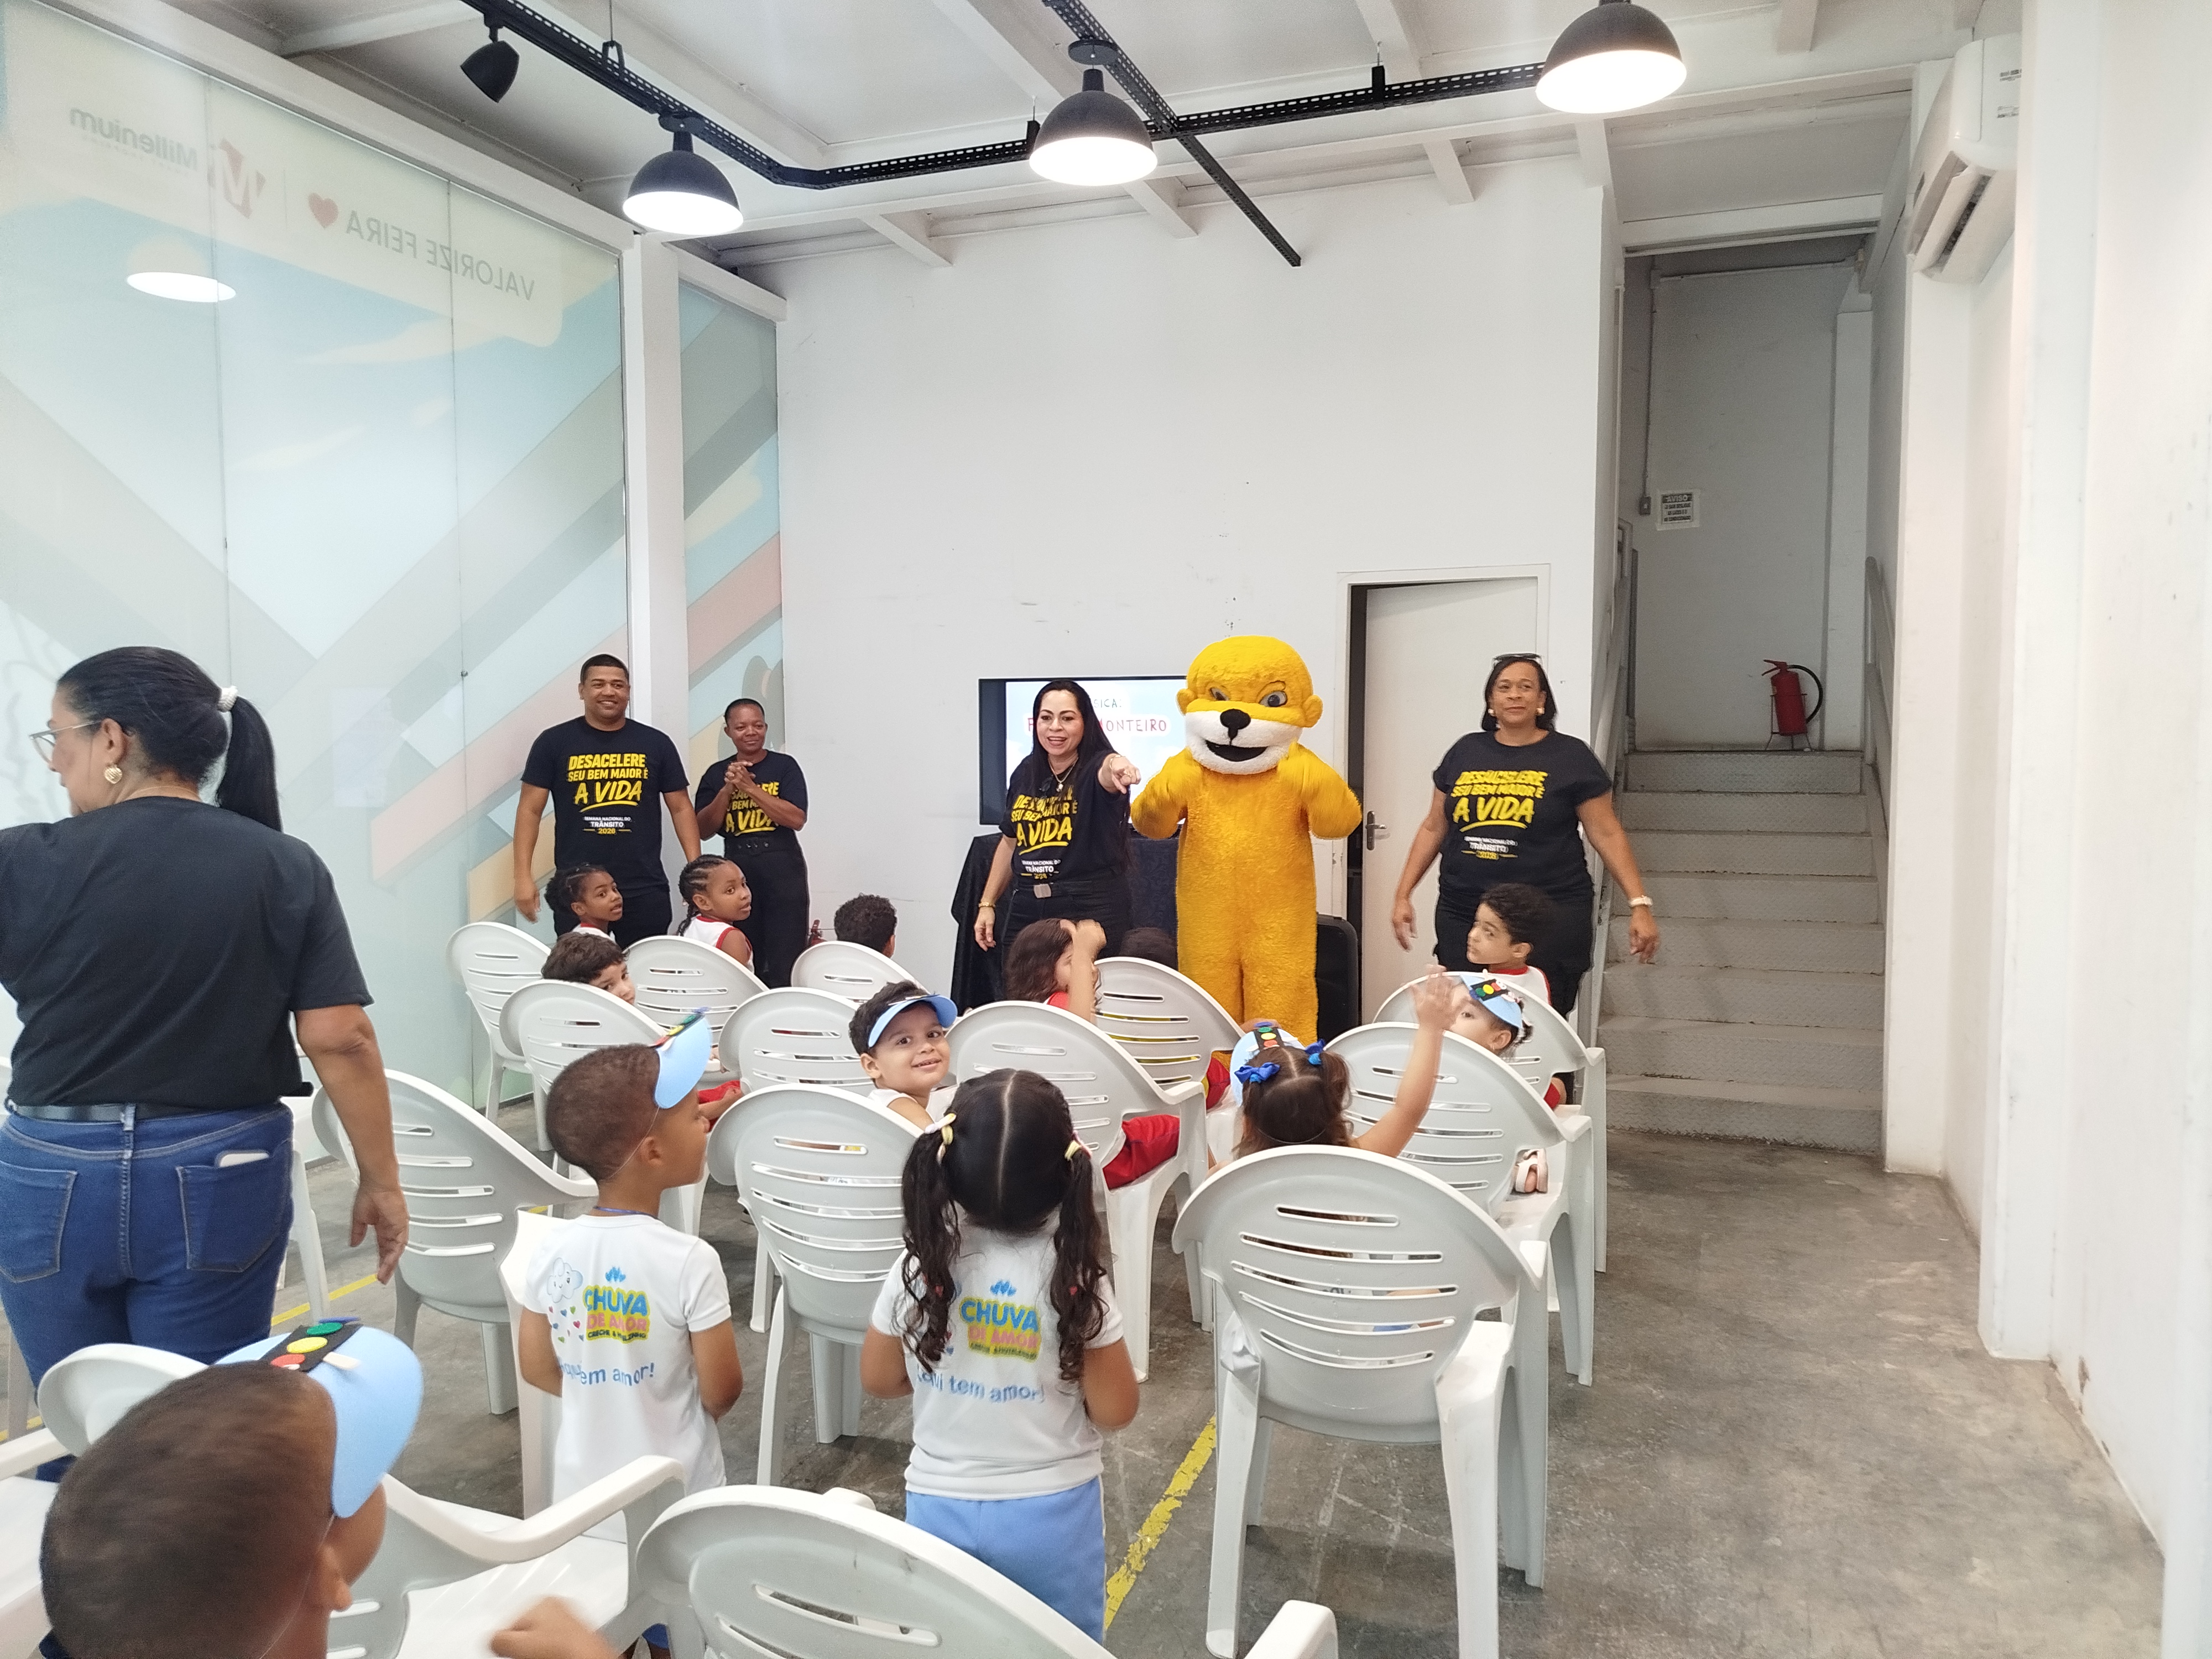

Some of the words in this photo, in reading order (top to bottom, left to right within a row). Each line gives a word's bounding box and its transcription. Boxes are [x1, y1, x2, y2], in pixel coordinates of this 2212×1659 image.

[1093, 698, 1122, 708] SICA:
[1100, 718, 1167, 732] ONTEIRO
[568, 753, 646, 770] DESACELERE
[568, 770, 586, 782] SEU
[587, 769, 608, 780] BEM
[610, 768, 642, 779] MAIOR
[644, 767, 649, 779] É
[575, 782, 589, 805] A
[596, 780, 643, 803] VIDA
[732, 800, 749, 811] BEM
[1452, 797, 1470, 823] A
[1477, 796, 1535, 824] VIDA
[726, 812, 735, 833] A
[1016, 822, 1027, 847] A
[1029, 816, 1073, 846] VIDA
[585, 1288, 648, 1317] CHUVA
[587, 1312, 606, 1329] DE
[609, 1314, 648, 1332] AMOR
[961, 1301, 1039, 1333] CHUVA
[990, 1328, 1039, 1348] AMOR
[581, 1369, 606, 1385] em
[613, 1362, 654, 1386] amor!
[949, 1375, 985, 1399] tem
